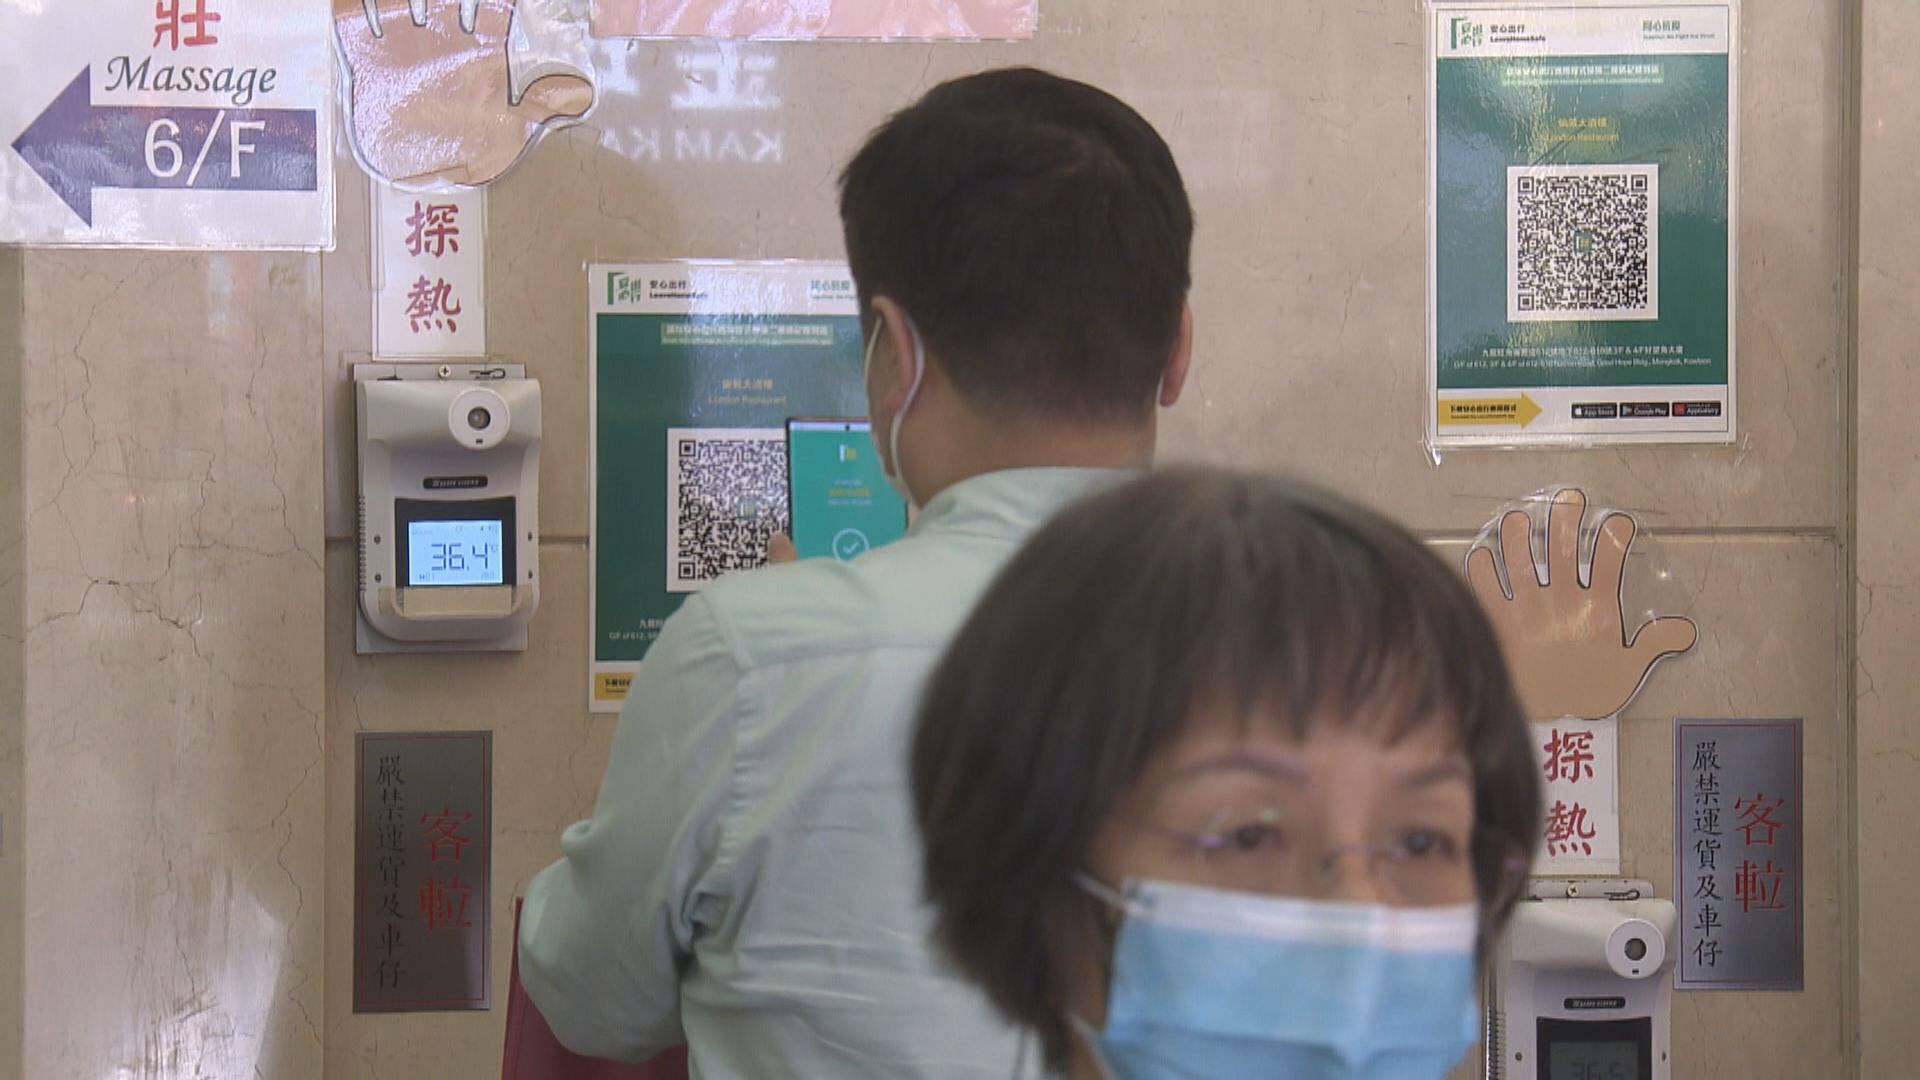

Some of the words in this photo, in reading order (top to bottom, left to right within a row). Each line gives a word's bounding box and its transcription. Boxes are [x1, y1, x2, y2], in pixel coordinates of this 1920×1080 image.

[105, 55, 277, 106] Massage
[143, 110, 265, 187] 6/F
[404, 201, 462, 334] 探熱
[431, 542, 488, 571] 36.4
[1543, 728, 1596, 857] 探熱
[1692, 740, 1723, 968] 嚴禁運貨及車仔
[375, 753, 407, 990] 嚴禁運貨及車仔
